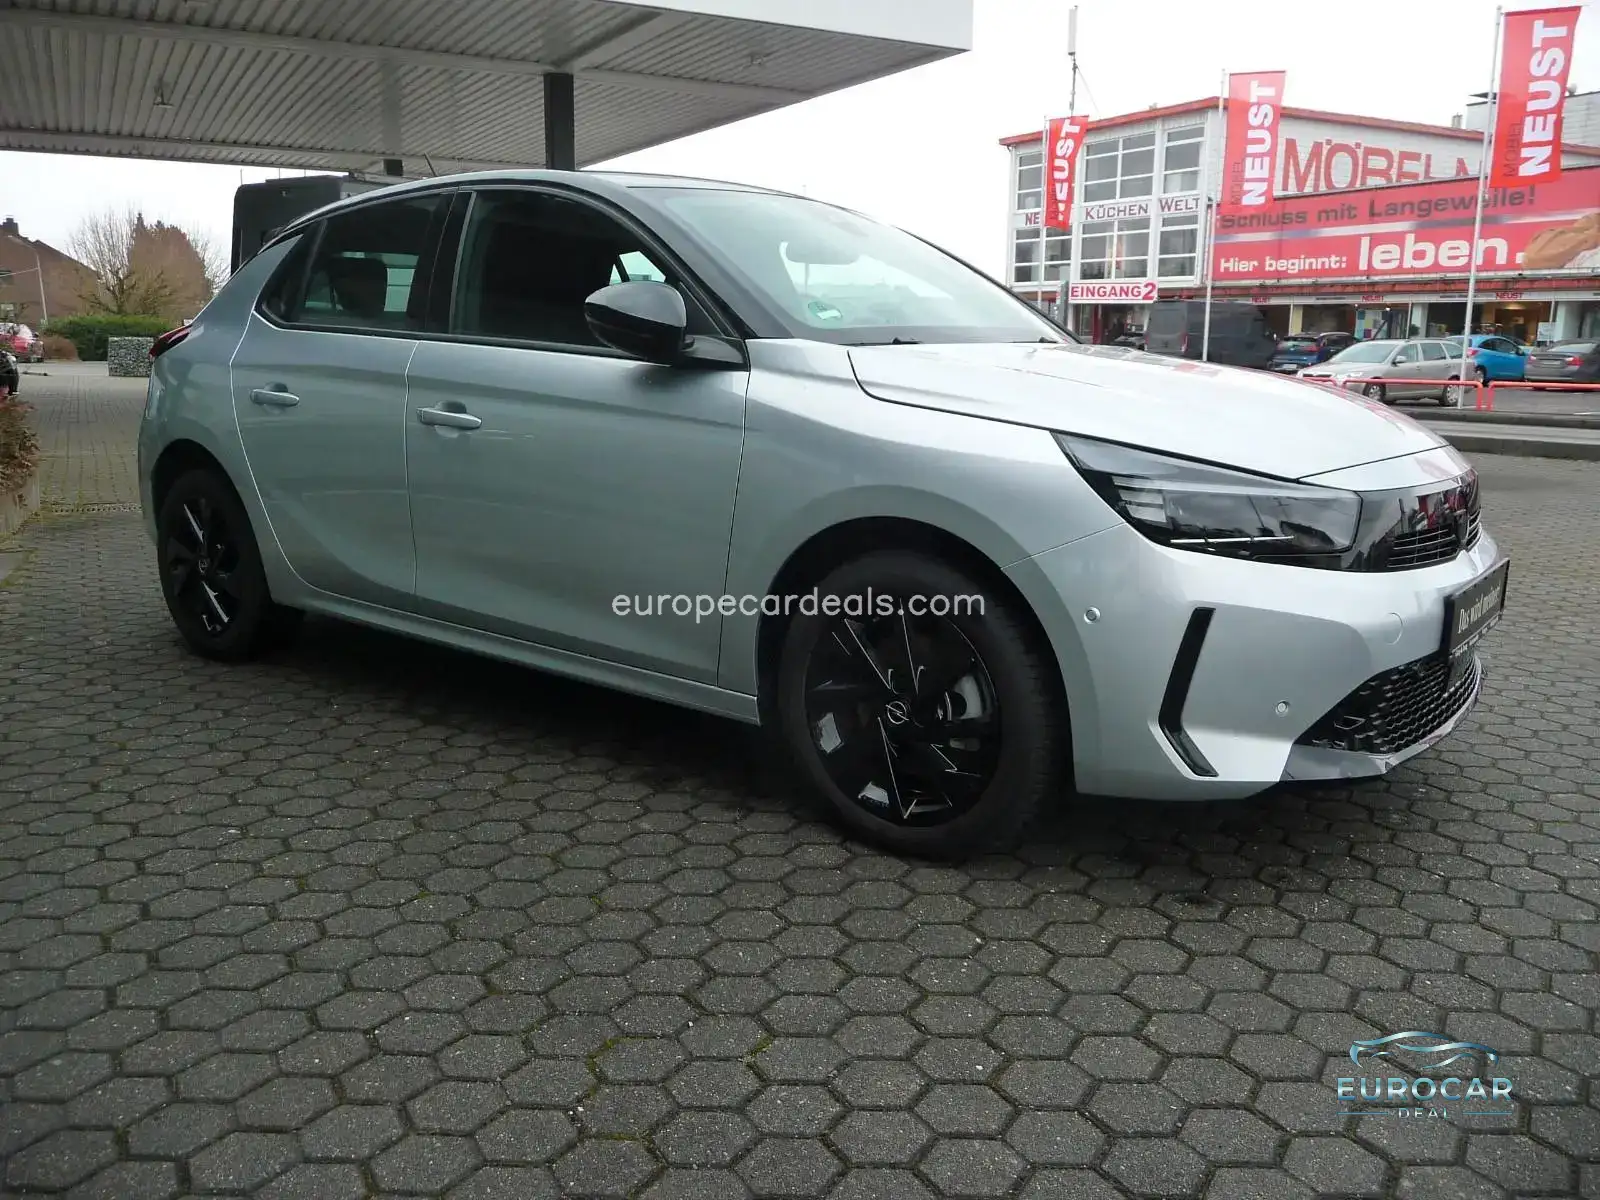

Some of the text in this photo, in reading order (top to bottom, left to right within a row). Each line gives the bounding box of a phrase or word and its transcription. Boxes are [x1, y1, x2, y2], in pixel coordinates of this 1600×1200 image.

[1518, 19, 1568, 177] NEUST
[1241, 80, 1276, 206] NEUST
[1085, 197, 1200, 221] KÜCHEN WELT
[1316, 203, 1358, 222] mit
[1219, 257, 1259, 273] Hier
[1264, 255, 1347, 273] beginnt:
